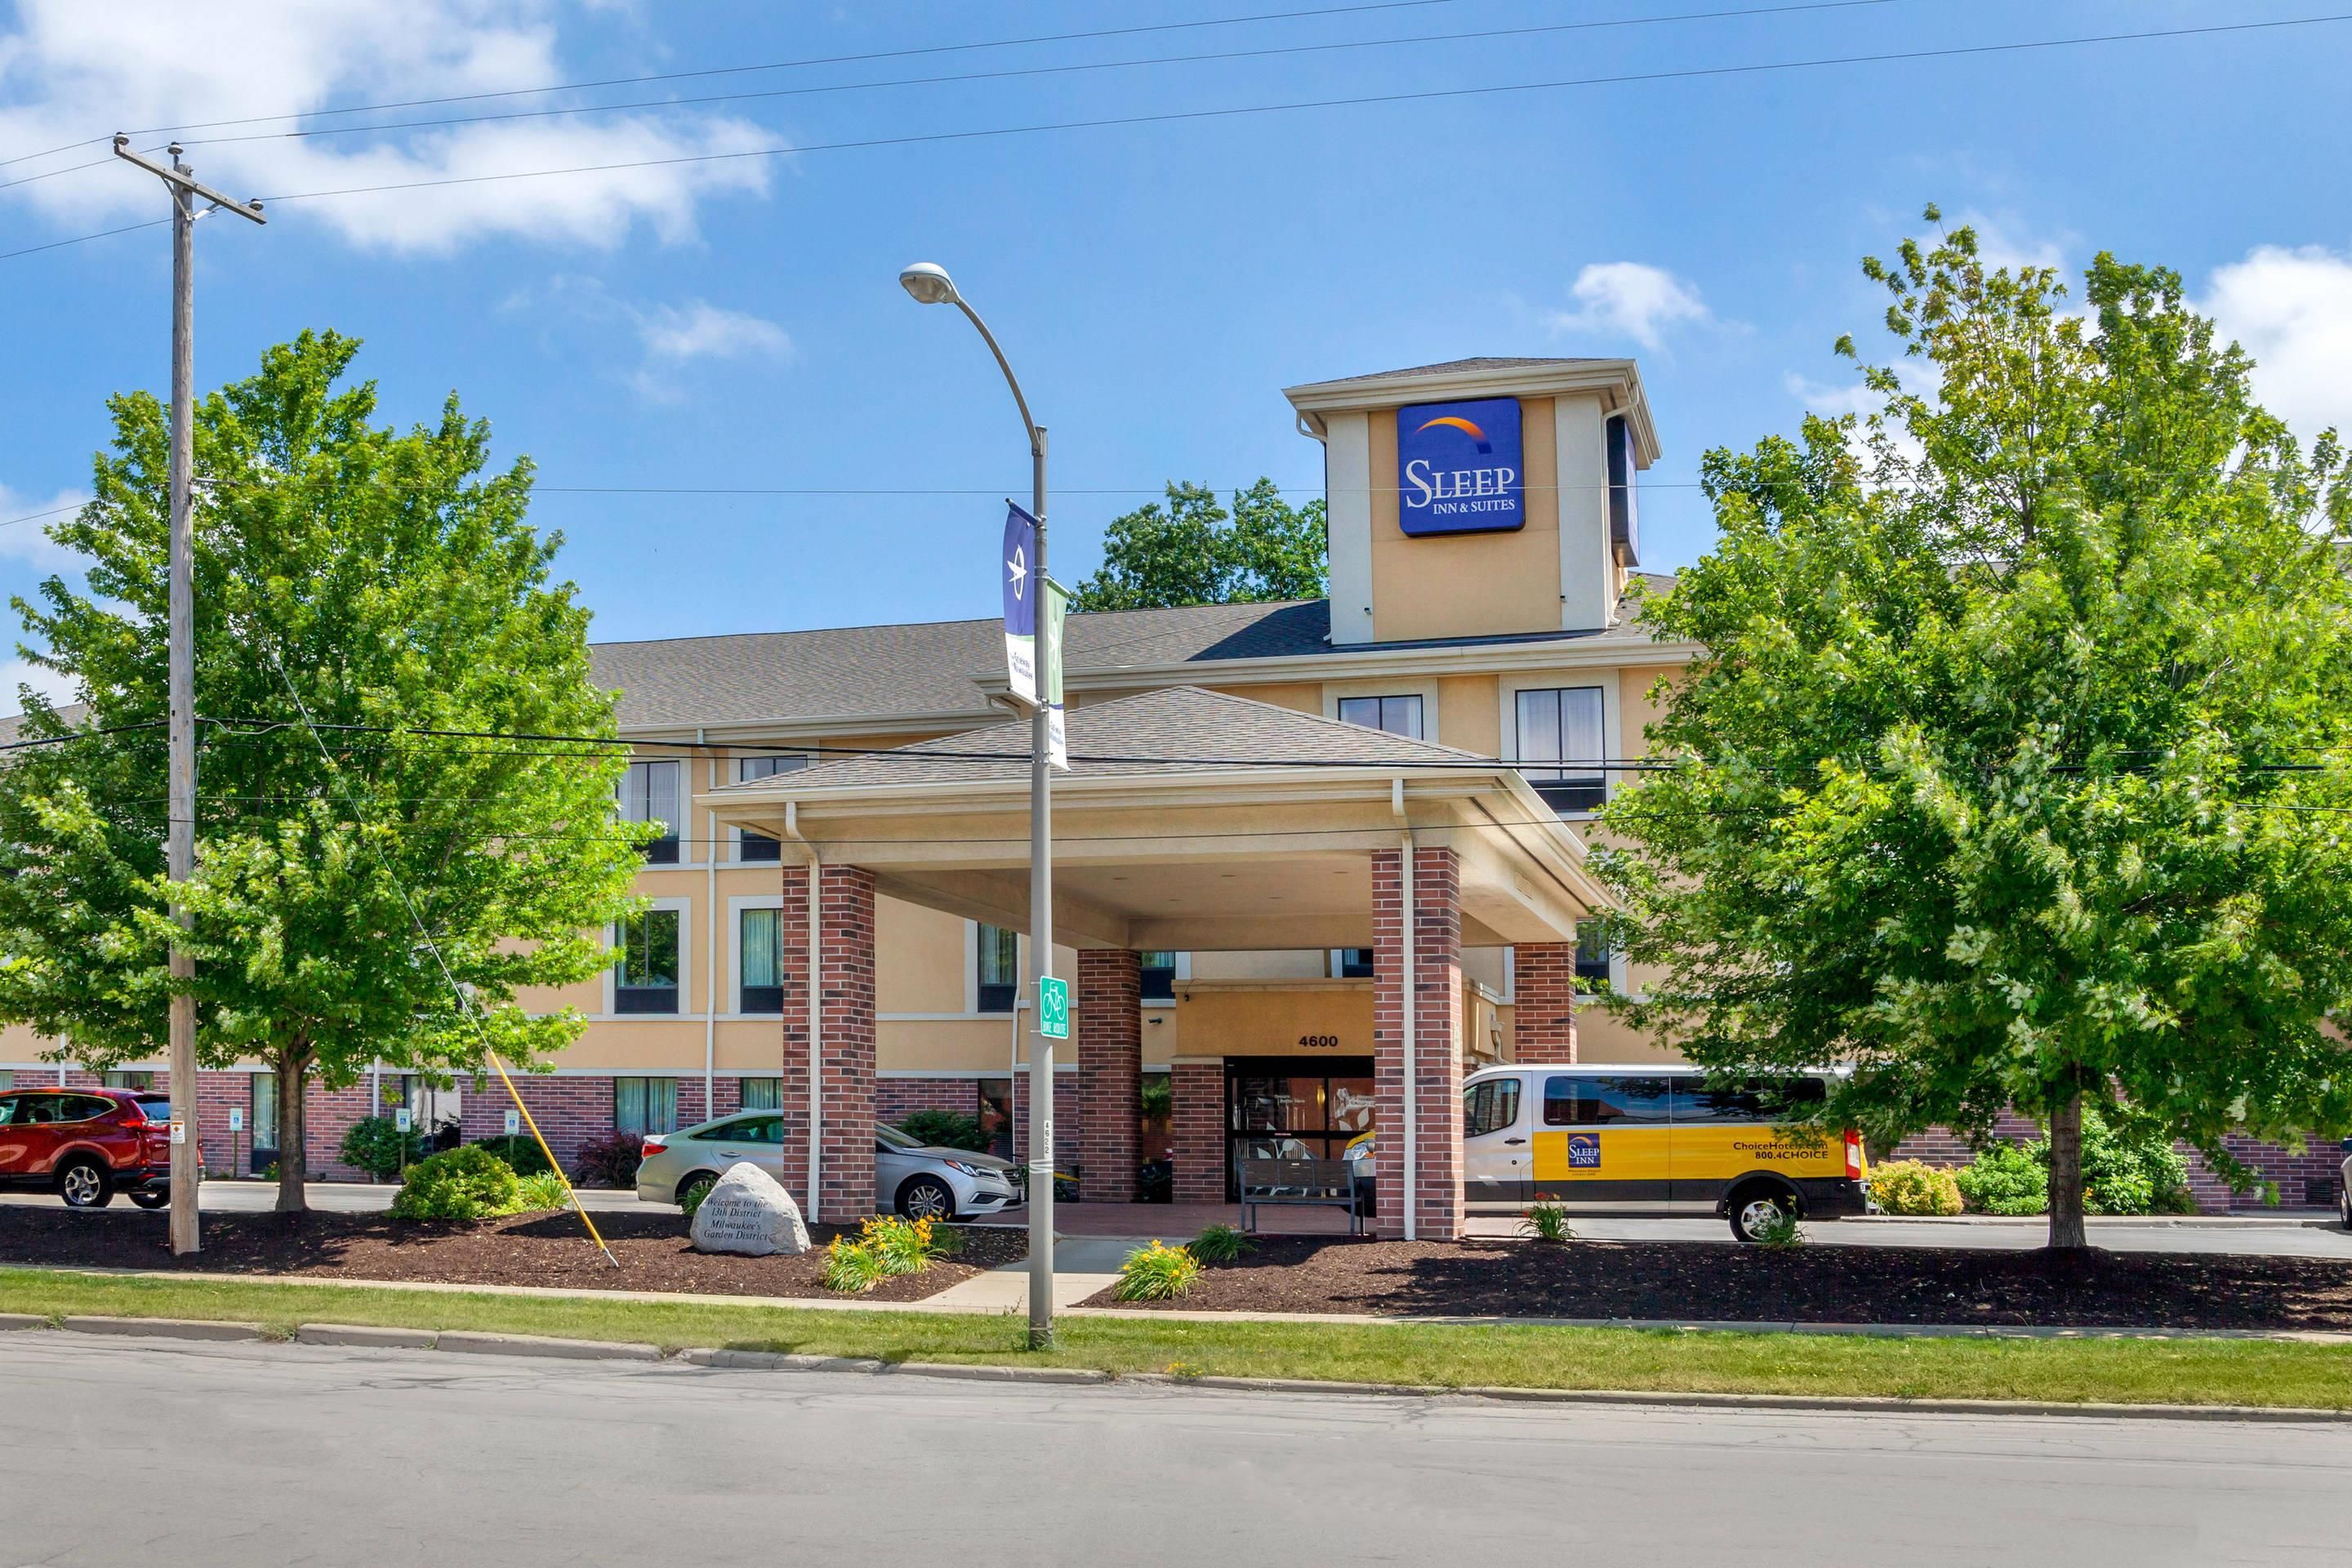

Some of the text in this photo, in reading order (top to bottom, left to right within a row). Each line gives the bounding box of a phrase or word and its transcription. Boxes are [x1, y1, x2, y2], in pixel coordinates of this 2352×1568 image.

[1405, 459, 1515, 509] SLEEP
[1432, 498, 1516, 515] INN & SUITES
[1298, 1035, 1339, 1047] 4600
[1568, 1144, 1600, 1159] SLEEP
[1755, 1151, 1829, 1160] 800.4CHOICE
[1575, 1156, 1595, 1165] INN
[706, 1197, 742, 1208] Welcome
[754, 1200, 768, 1209] the
[711, 1207, 762, 1218] 13th District
[710, 1219, 761, 1230] Milwaukee's
[704, 1229, 768, 1241] Garden District
